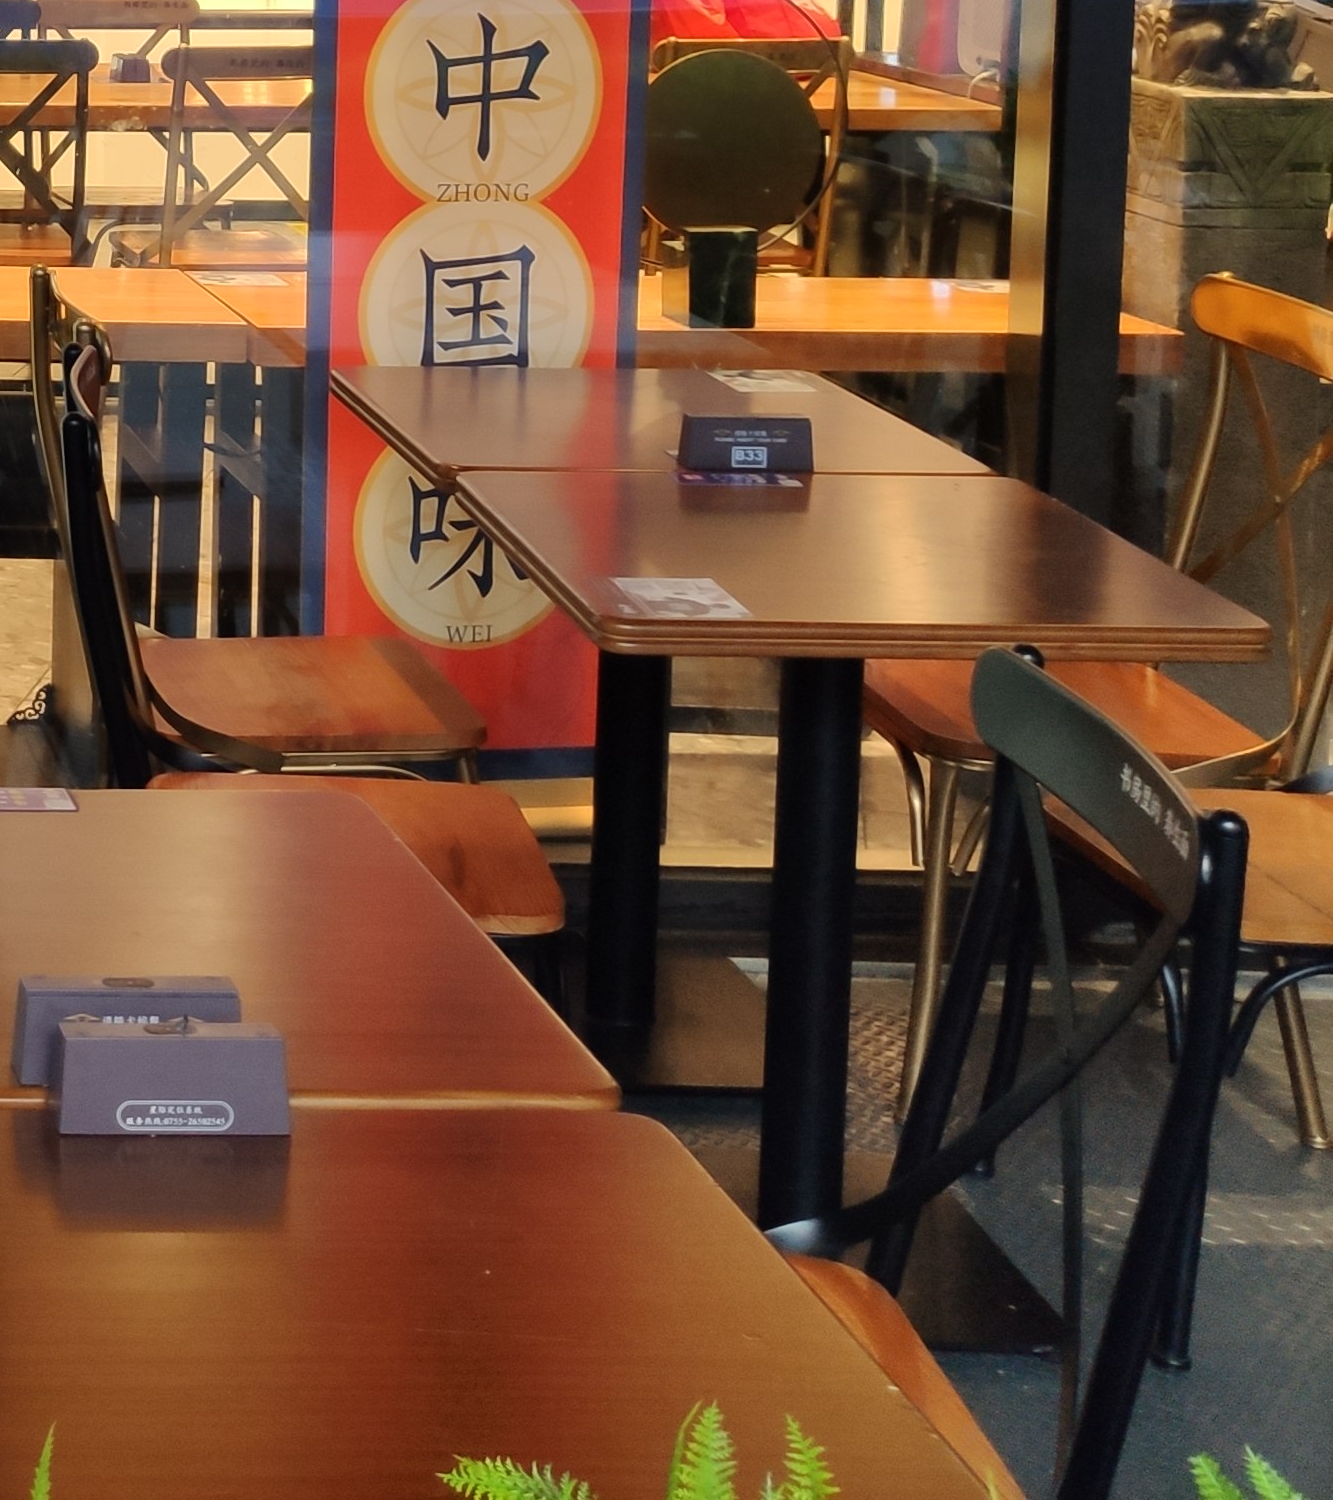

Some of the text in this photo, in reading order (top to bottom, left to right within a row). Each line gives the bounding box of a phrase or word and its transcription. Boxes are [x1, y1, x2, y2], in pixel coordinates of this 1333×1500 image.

[436, 182, 531, 204] ZHONG
[735, 450, 764, 461] B33
[446, 624, 493, 644] WEI
